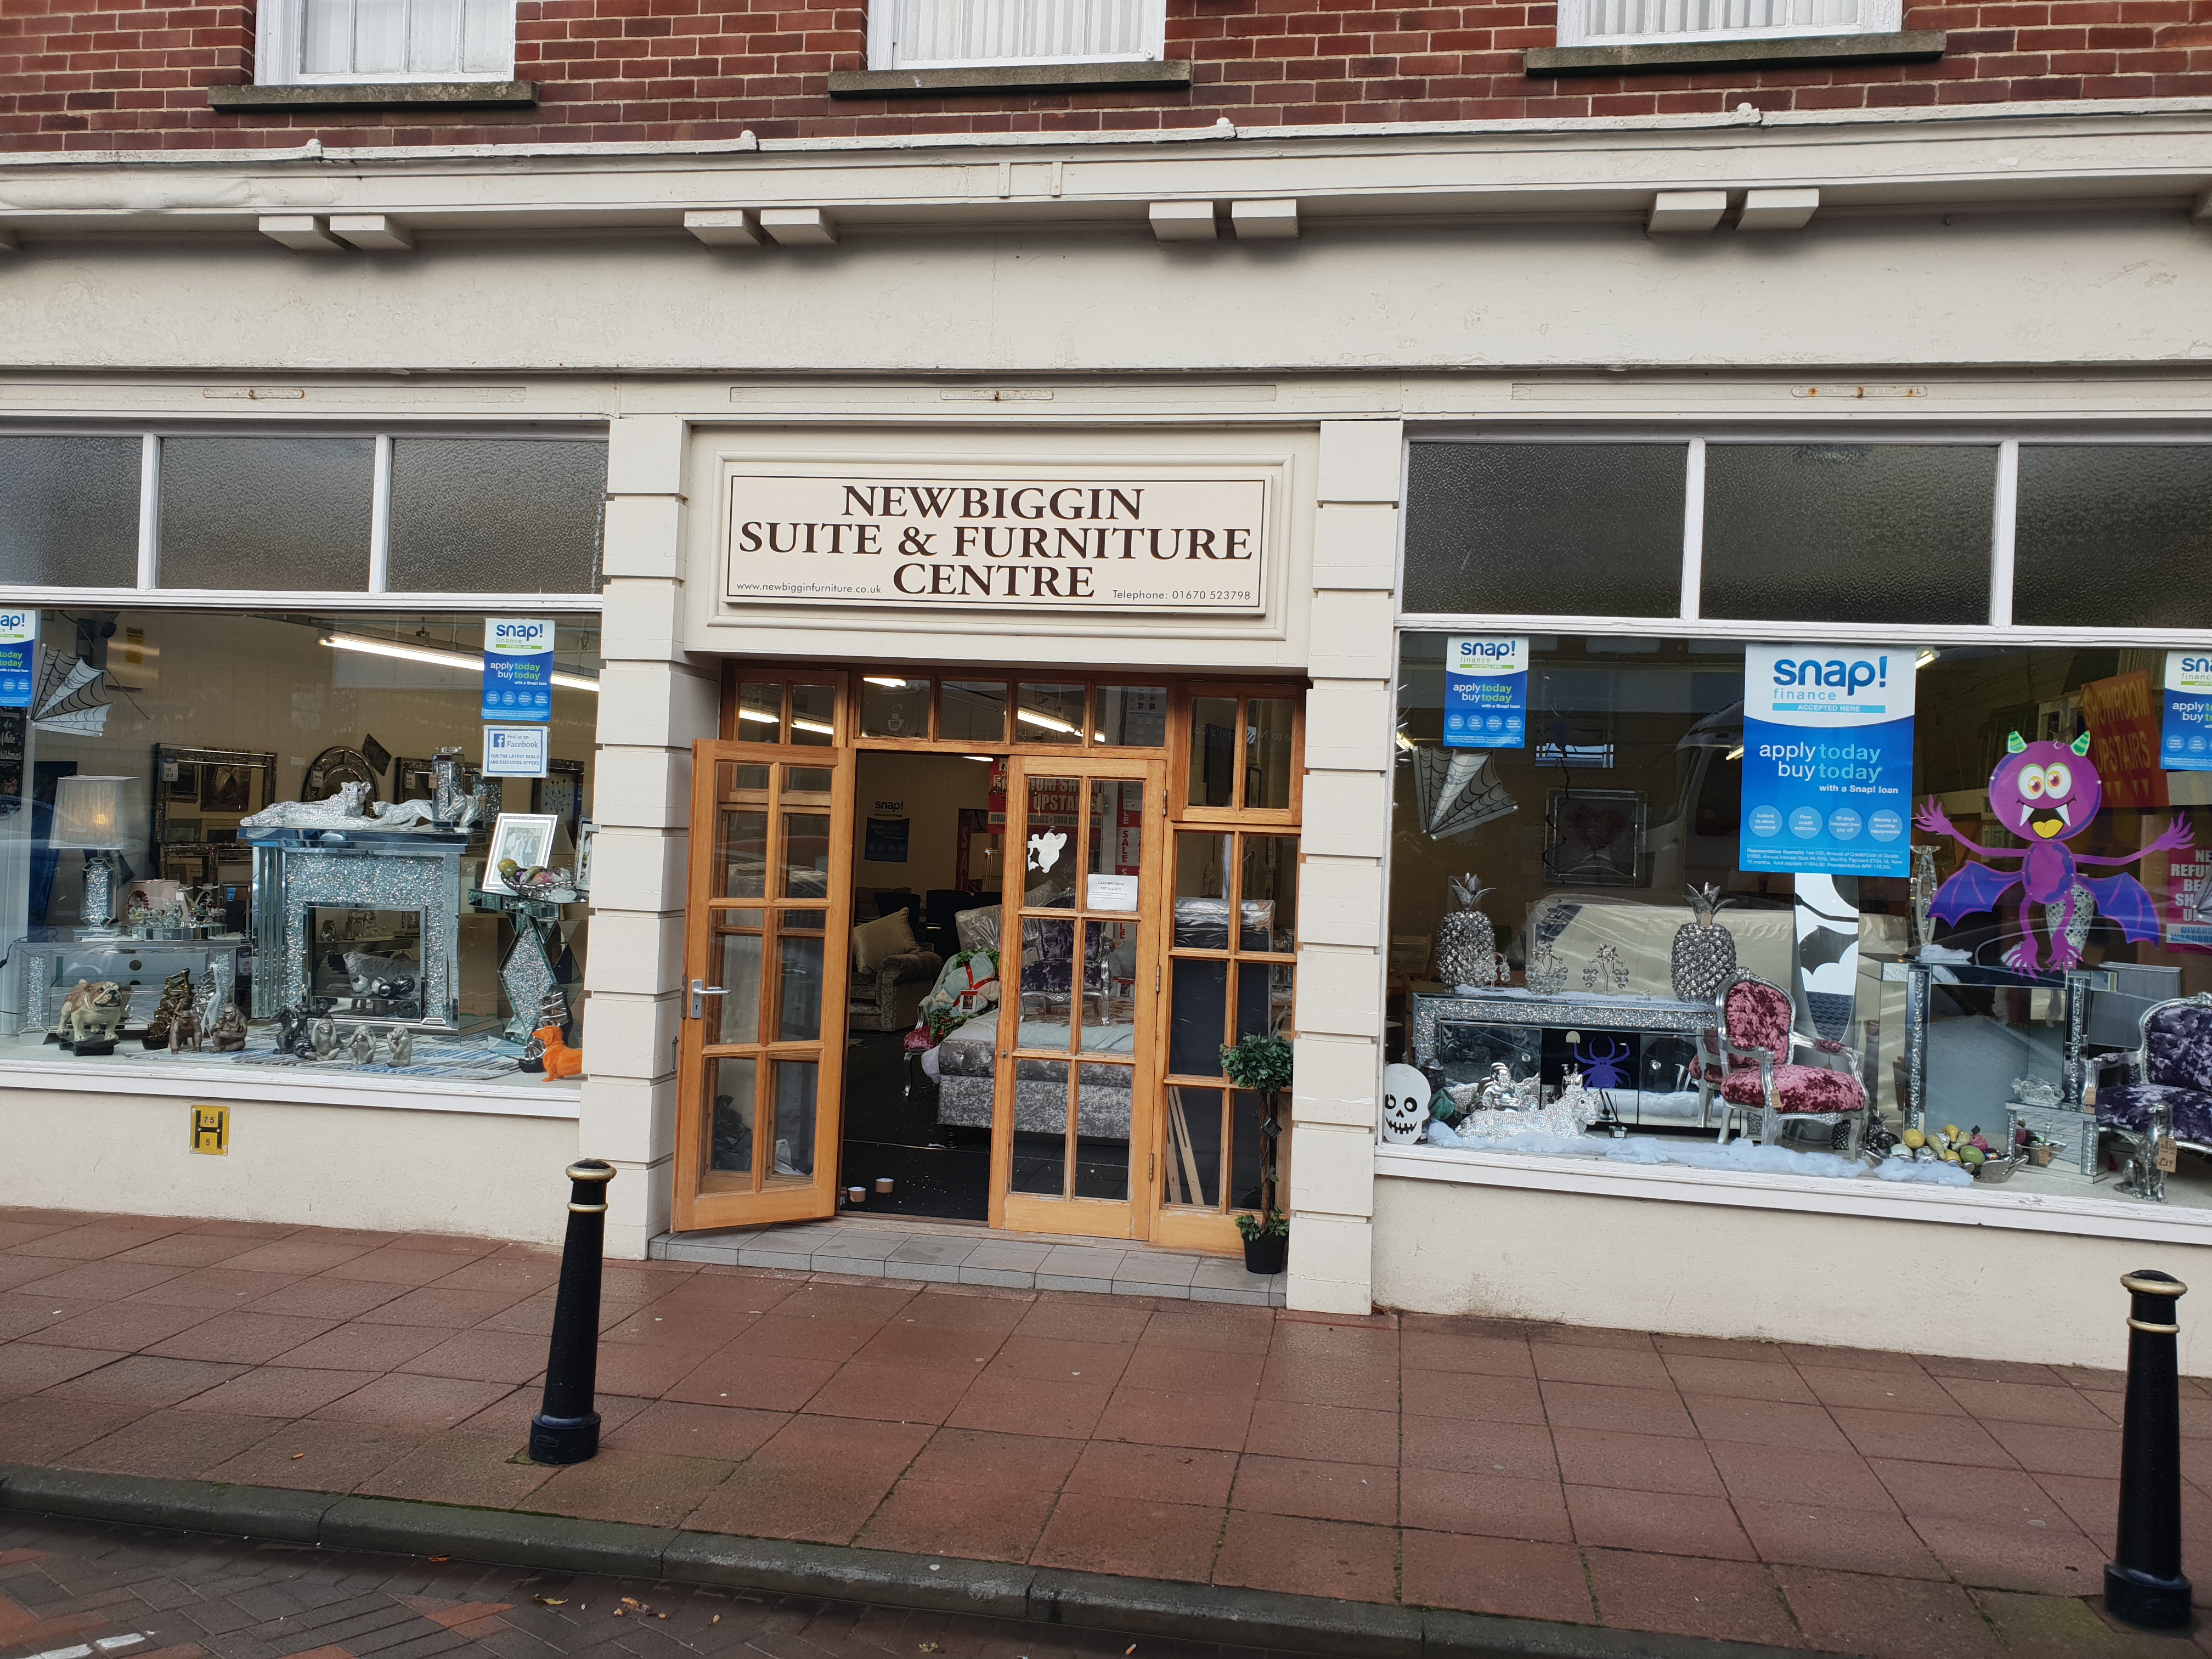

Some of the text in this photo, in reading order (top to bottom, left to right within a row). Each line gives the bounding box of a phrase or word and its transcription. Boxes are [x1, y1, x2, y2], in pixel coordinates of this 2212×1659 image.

[841, 486, 1145, 520] NEWBIGGIN
[739, 521, 1252, 560] SUITE & FURNITURE
[893, 562, 1094, 597] CENTRE
[736, 582, 882, 596] www.newbigginfurniture.co.uk
[1112, 589, 1251, 601] Telephone: 01670 523798
[0, 613, 25, 630] ap!
[496, 623, 543, 641] snap!
[1460, 640, 1516, 661] snap!
[490, 662, 540, 672] apply today
[2181, 657, 2212, 673] sn
[498, 670, 541, 681] buy today
[1773, 656, 1888, 696] snap!
[1453, 683, 1512, 694] apply today
[1773, 687, 1837, 701] finance
[1462, 692, 1513, 703] buy today
[2084, 679, 2150, 729] SHOWROOM
[1797, 704, 1838, 712] ACCEPTED
[2172, 701, 2204, 712] apply
[2182, 712, 2203, 723] buy
[1759, 741, 1881, 764] apply today
[2094, 730, 2151, 774] UPSTAIRS
[1778, 760, 1882, 783] buy today
[1819, 784, 1839, 792] with
[1849, 785, 1876, 794] Snap!
[1878, 786, 1899, 794] loan
[874, 801, 904, 812] snap!
[1053, 816, 1065, 824] SOFA
[194, 1110, 223, 1150] H
